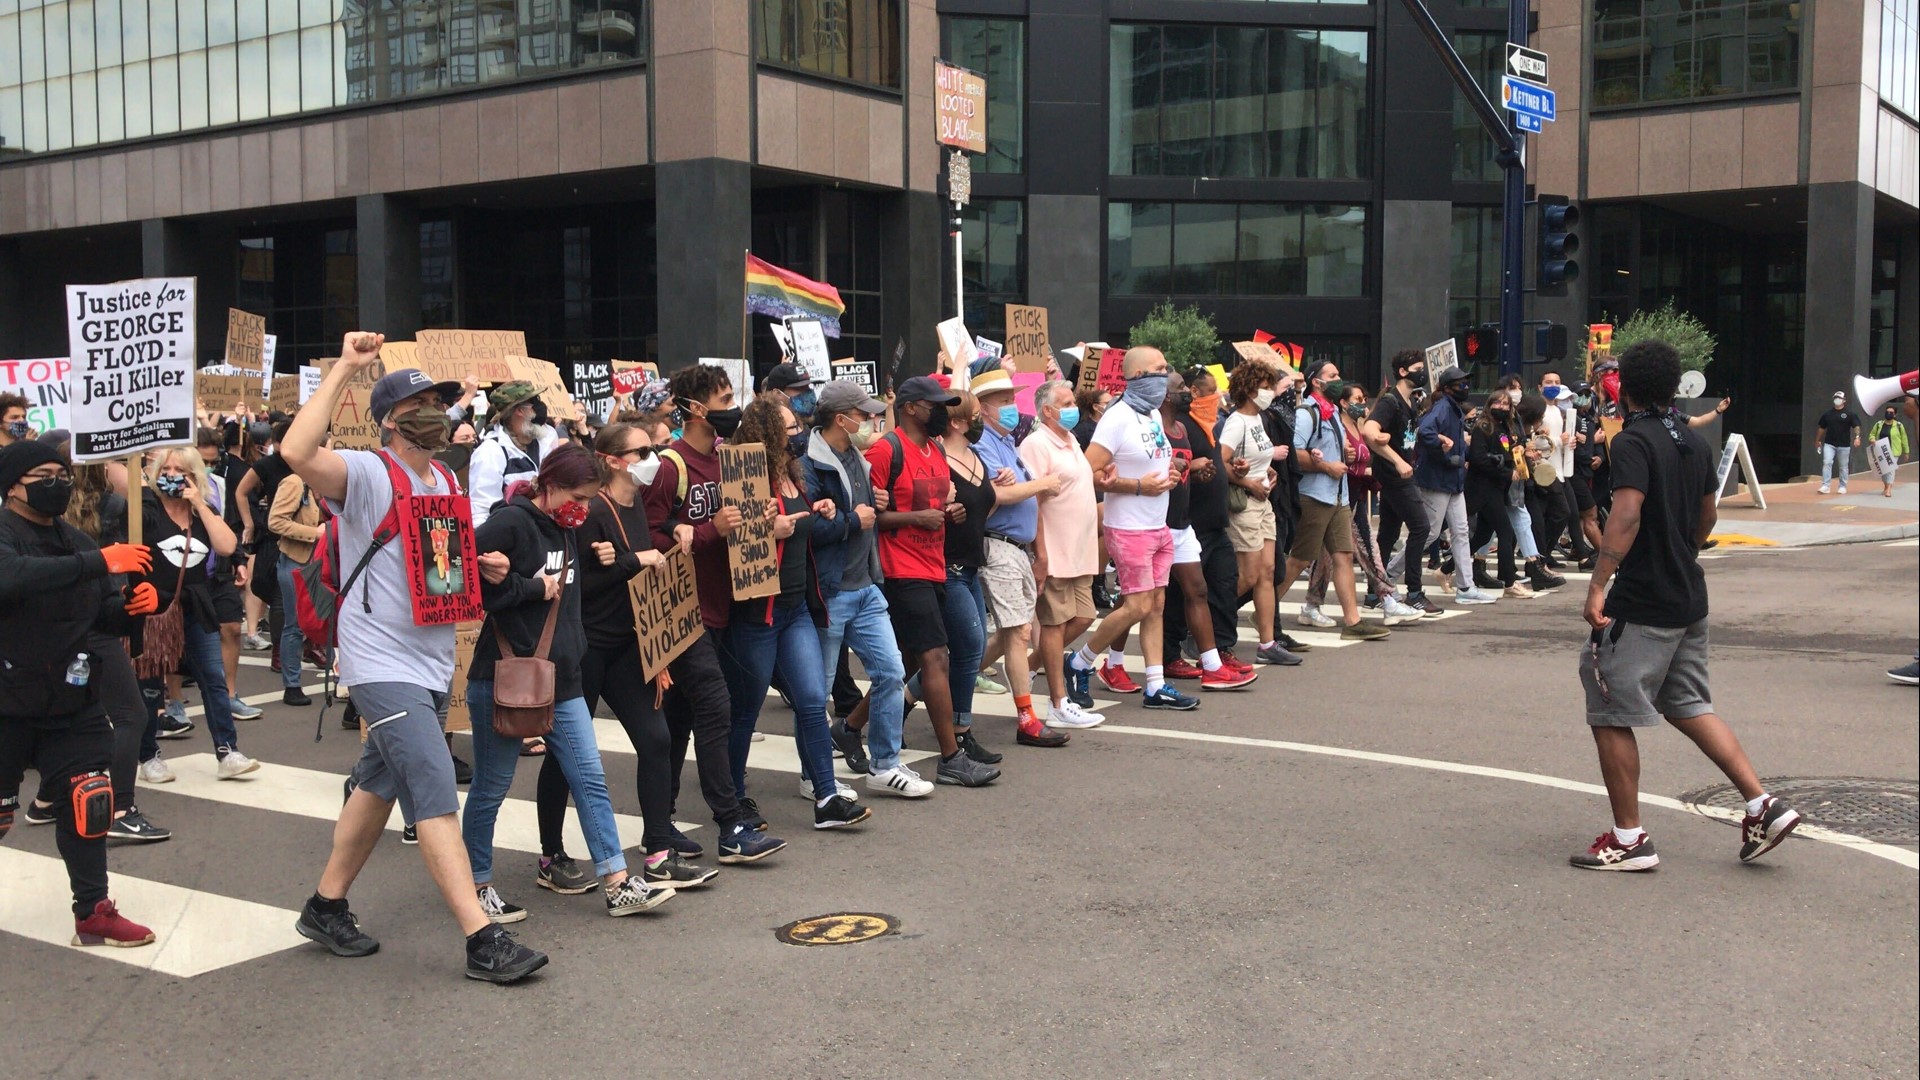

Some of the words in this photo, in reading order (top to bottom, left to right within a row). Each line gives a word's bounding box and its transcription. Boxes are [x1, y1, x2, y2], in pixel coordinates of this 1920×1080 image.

[1520, 57, 1531, 71] ONE
[1533, 61, 1544, 74] WAY
[936, 65, 963, 93] WHITE
[941, 93, 974, 117] LOOTED
[942, 115, 968, 141] BLACK
[76, 288, 152, 320] Justice
[156, 281, 187, 309] for
[82, 311, 183, 343] GEORGE
[230, 310, 263, 332] BLACK
[1013, 308, 1042, 331] FUCK
[230, 325, 260, 347] LIVES
[421, 332, 465, 346] WHO
[471, 332, 493, 346] DO
[495, 331, 524, 346] YOU
[1008, 332, 1045, 358] TRUMP
[87, 339, 176, 371] FLOYD:
[229, 340, 262, 366] MATTER
[424, 346, 458, 360] CALL
[460, 347, 496, 360] WHEN
[498, 346, 524, 360] THE
[427, 362, 472, 379] POLICE
[574, 363, 609, 379] BLACK
[618, 371, 643, 386] VOTE
[836, 364, 869, 375] BLACK
[1083, 347, 1101, 390] #BLM
[83, 373, 123, 405] Jail
[128, 365, 185, 393] Killer
[108, 391, 160, 425] Cops!
[90, 433, 118, 443] Party
[120, 429, 131, 438] for
[133, 421, 175, 435] Socialism
[331, 423, 367, 437] Cannot
[93, 442, 111, 452] and
[113, 433, 154, 449] Liberation
[1145, 446, 1172, 460] VOTE
[1881, 444, 1894, 466] SILENCE
[410, 497, 456, 518] BLACK
[408, 521, 423, 596] LIVES
[460, 520, 475, 596] MATTER
[741, 540, 769, 564] SHOULD
[633, 550, 687, 608] WHITE
[753, 564, 764, 585] die
[420, 597, 438, 610] NOW
[442, 596, 453, 607] DO
[457, 595, 471, 606] YOU
[422, 602, 484, 622] UNDERSTAND?
[638, 573, 695, 637] SILENCE
[665, 614, 673, 628] IS
[643, 605, 702, 669] VIOLENCE
